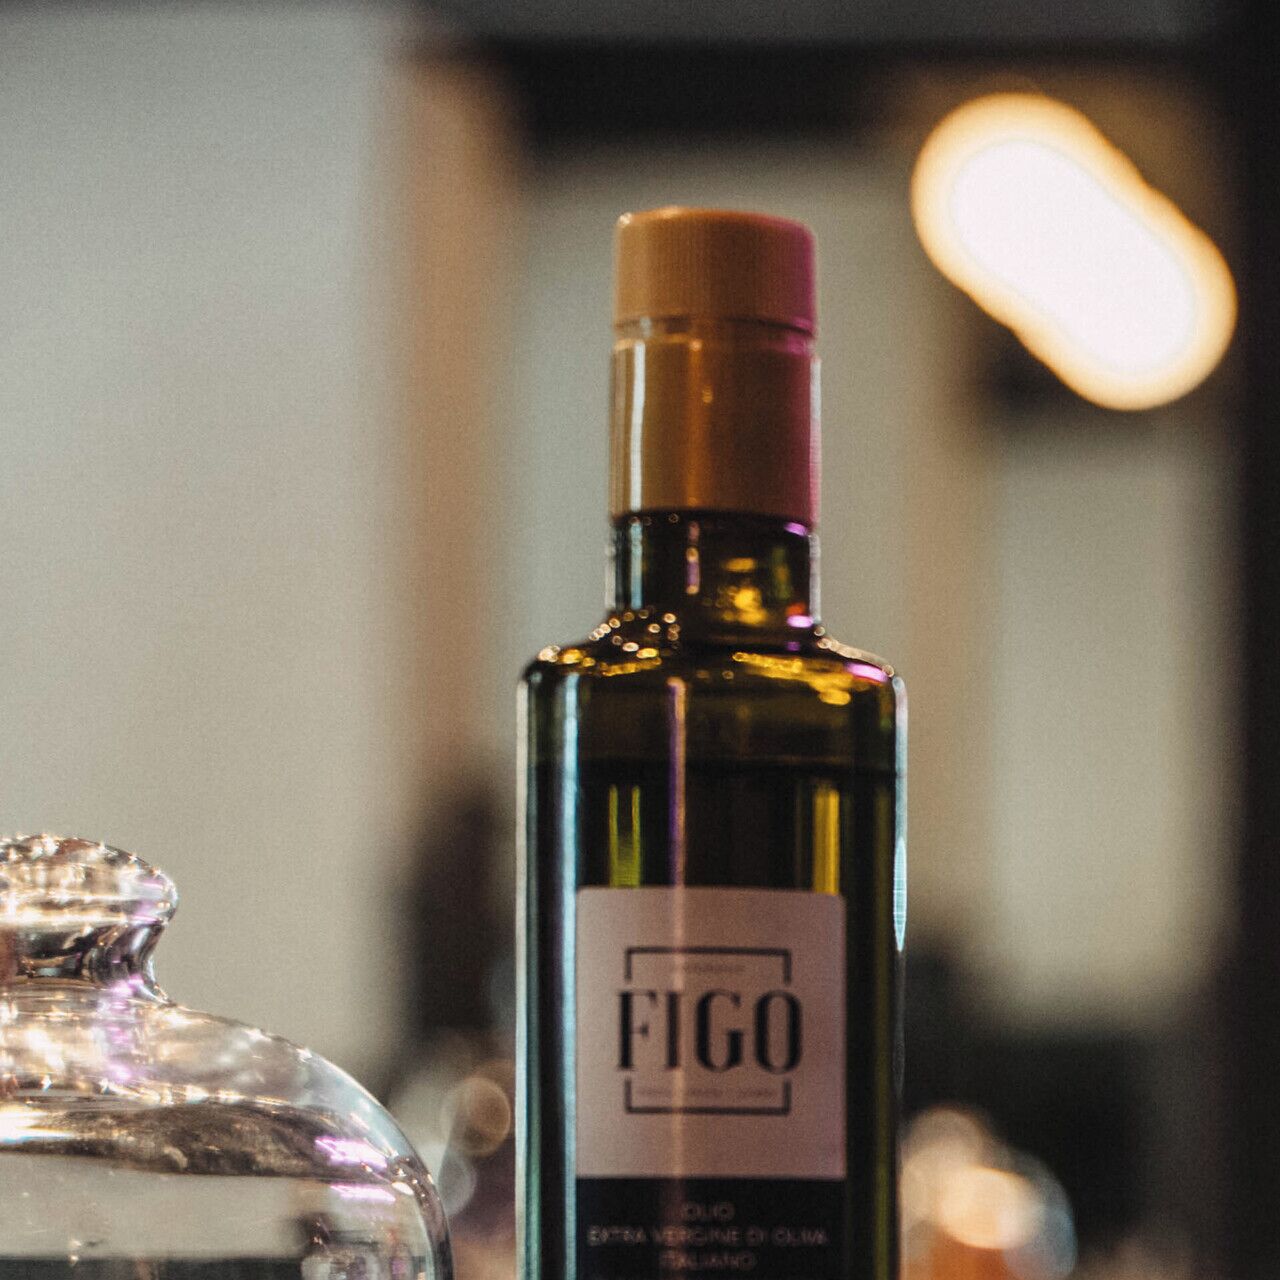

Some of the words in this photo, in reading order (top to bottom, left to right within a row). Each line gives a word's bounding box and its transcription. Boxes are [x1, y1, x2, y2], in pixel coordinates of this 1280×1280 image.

[617, 988, 803, 1074] FIGO
[682, 1202, 735, 1220] OLIO
[587, 1225, 647, 1246] EXTRA
[652, 1225, 740, 1246] VERGINE
[746, 1225, 767, 1246] DI
